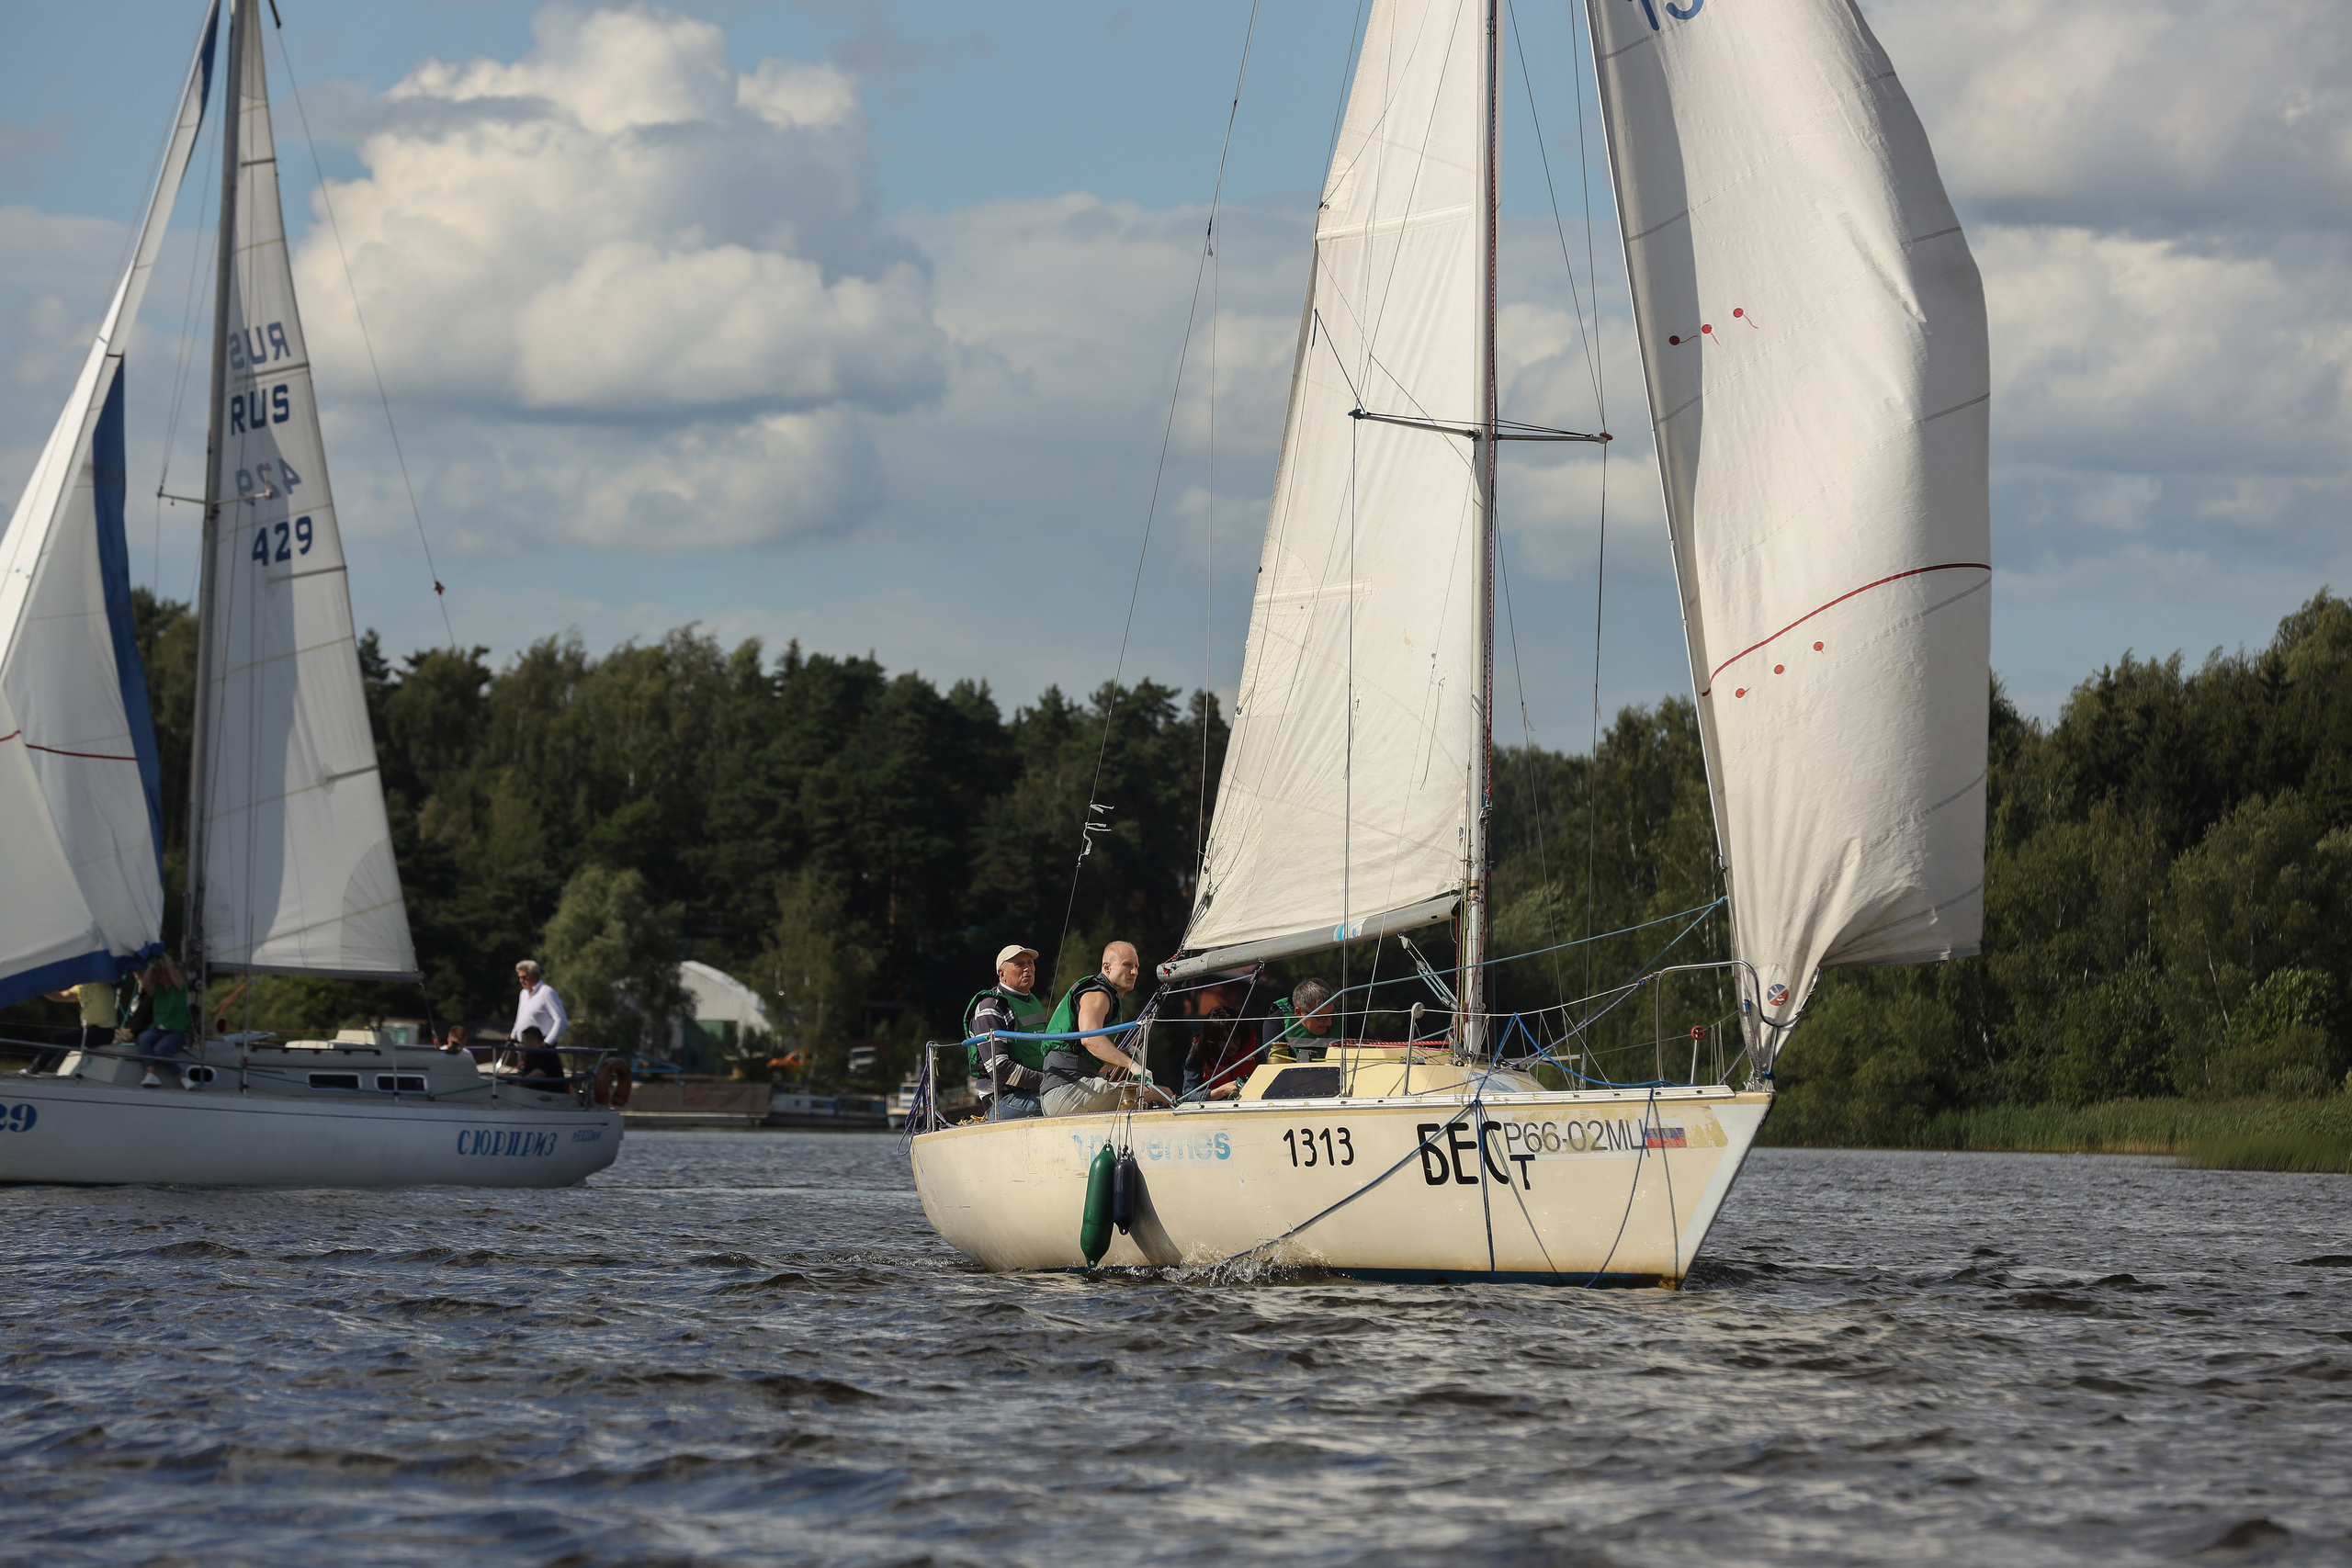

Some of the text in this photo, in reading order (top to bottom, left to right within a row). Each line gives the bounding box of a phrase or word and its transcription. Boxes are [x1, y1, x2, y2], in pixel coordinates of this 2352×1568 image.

[231, 384, 289, 435] RUS
[252, 515, 312, 567] 429
[457, 1130, 558, 1156] СЮРПРИЗ
[1283, 1127, 1355, 1168] 1313
